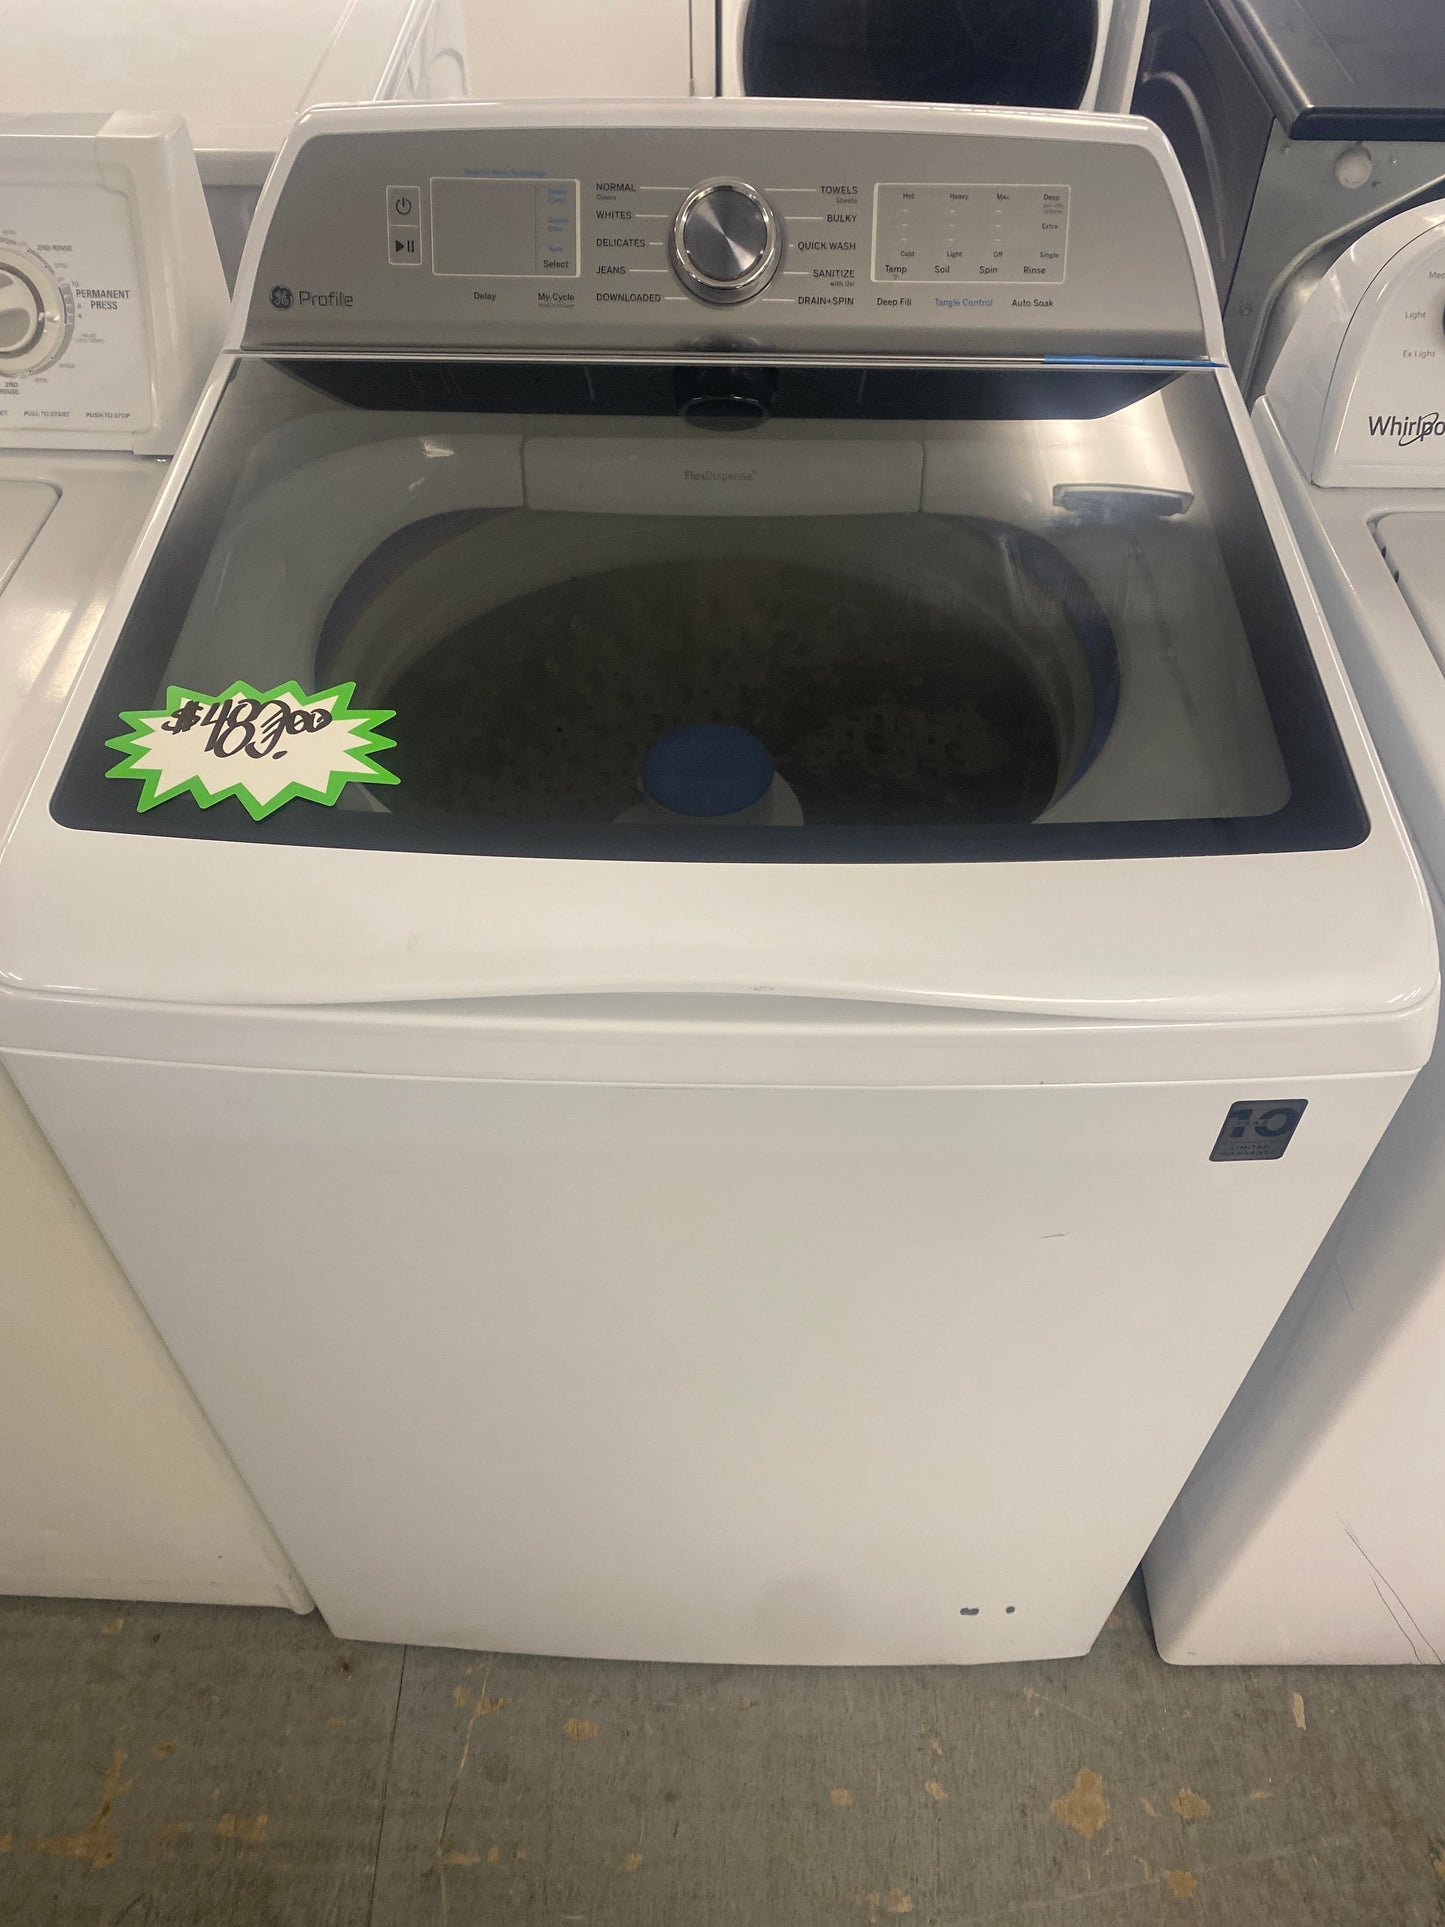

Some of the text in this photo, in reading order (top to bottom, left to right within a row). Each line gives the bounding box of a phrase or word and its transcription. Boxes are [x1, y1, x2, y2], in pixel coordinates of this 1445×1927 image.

[595, 182, 637, 193] NORMAL
[820, 185, 859, 195] TOWELS
[949, 192, 969, 201] Heavy
[1043, 193, 1060, 201] Deep
[595, 210, 632, 220] WHITES
[826, 213, 858, 223] BULKY
[595, 238, 646, 248] DELICATES
[797, 240, 857, 251] QUICK WASH
[900, 250, 915, 258] Cold
[543, 259, 569, 269] Select
[595, 265, 626, 275] JEANS
[812, 268, 855, 278] SANITIZE
[885, 264, 908, 275] Temp
[934, 265, 950, 274] Soil
[979, 265, 998, 276] Spin
[1023, 266, 1046, 275] Rinse
[75, 289, 130, 299] PERMANENT
[298, 290, 354, 307] Profile
[473, 291, 497, 302] Delay
[537, 292, 575, 303] My Cycle
[595, 292, 662, 303] DOWNLOADED
[90, 300, 118, 310] PRESS
[797, 296, 855, 306] DRAIN+SPIN
[876, 297, 912, 308] Deep Fill
[935, 298, 993, 308] Tangle Control
[1011, 298, 1054, 308] Auto Soak
[1404, 310, 1427, 320] Light
[1402, 349, 1436, 359] Ex Light
[1228, 1107, 1299, 1138] 10
